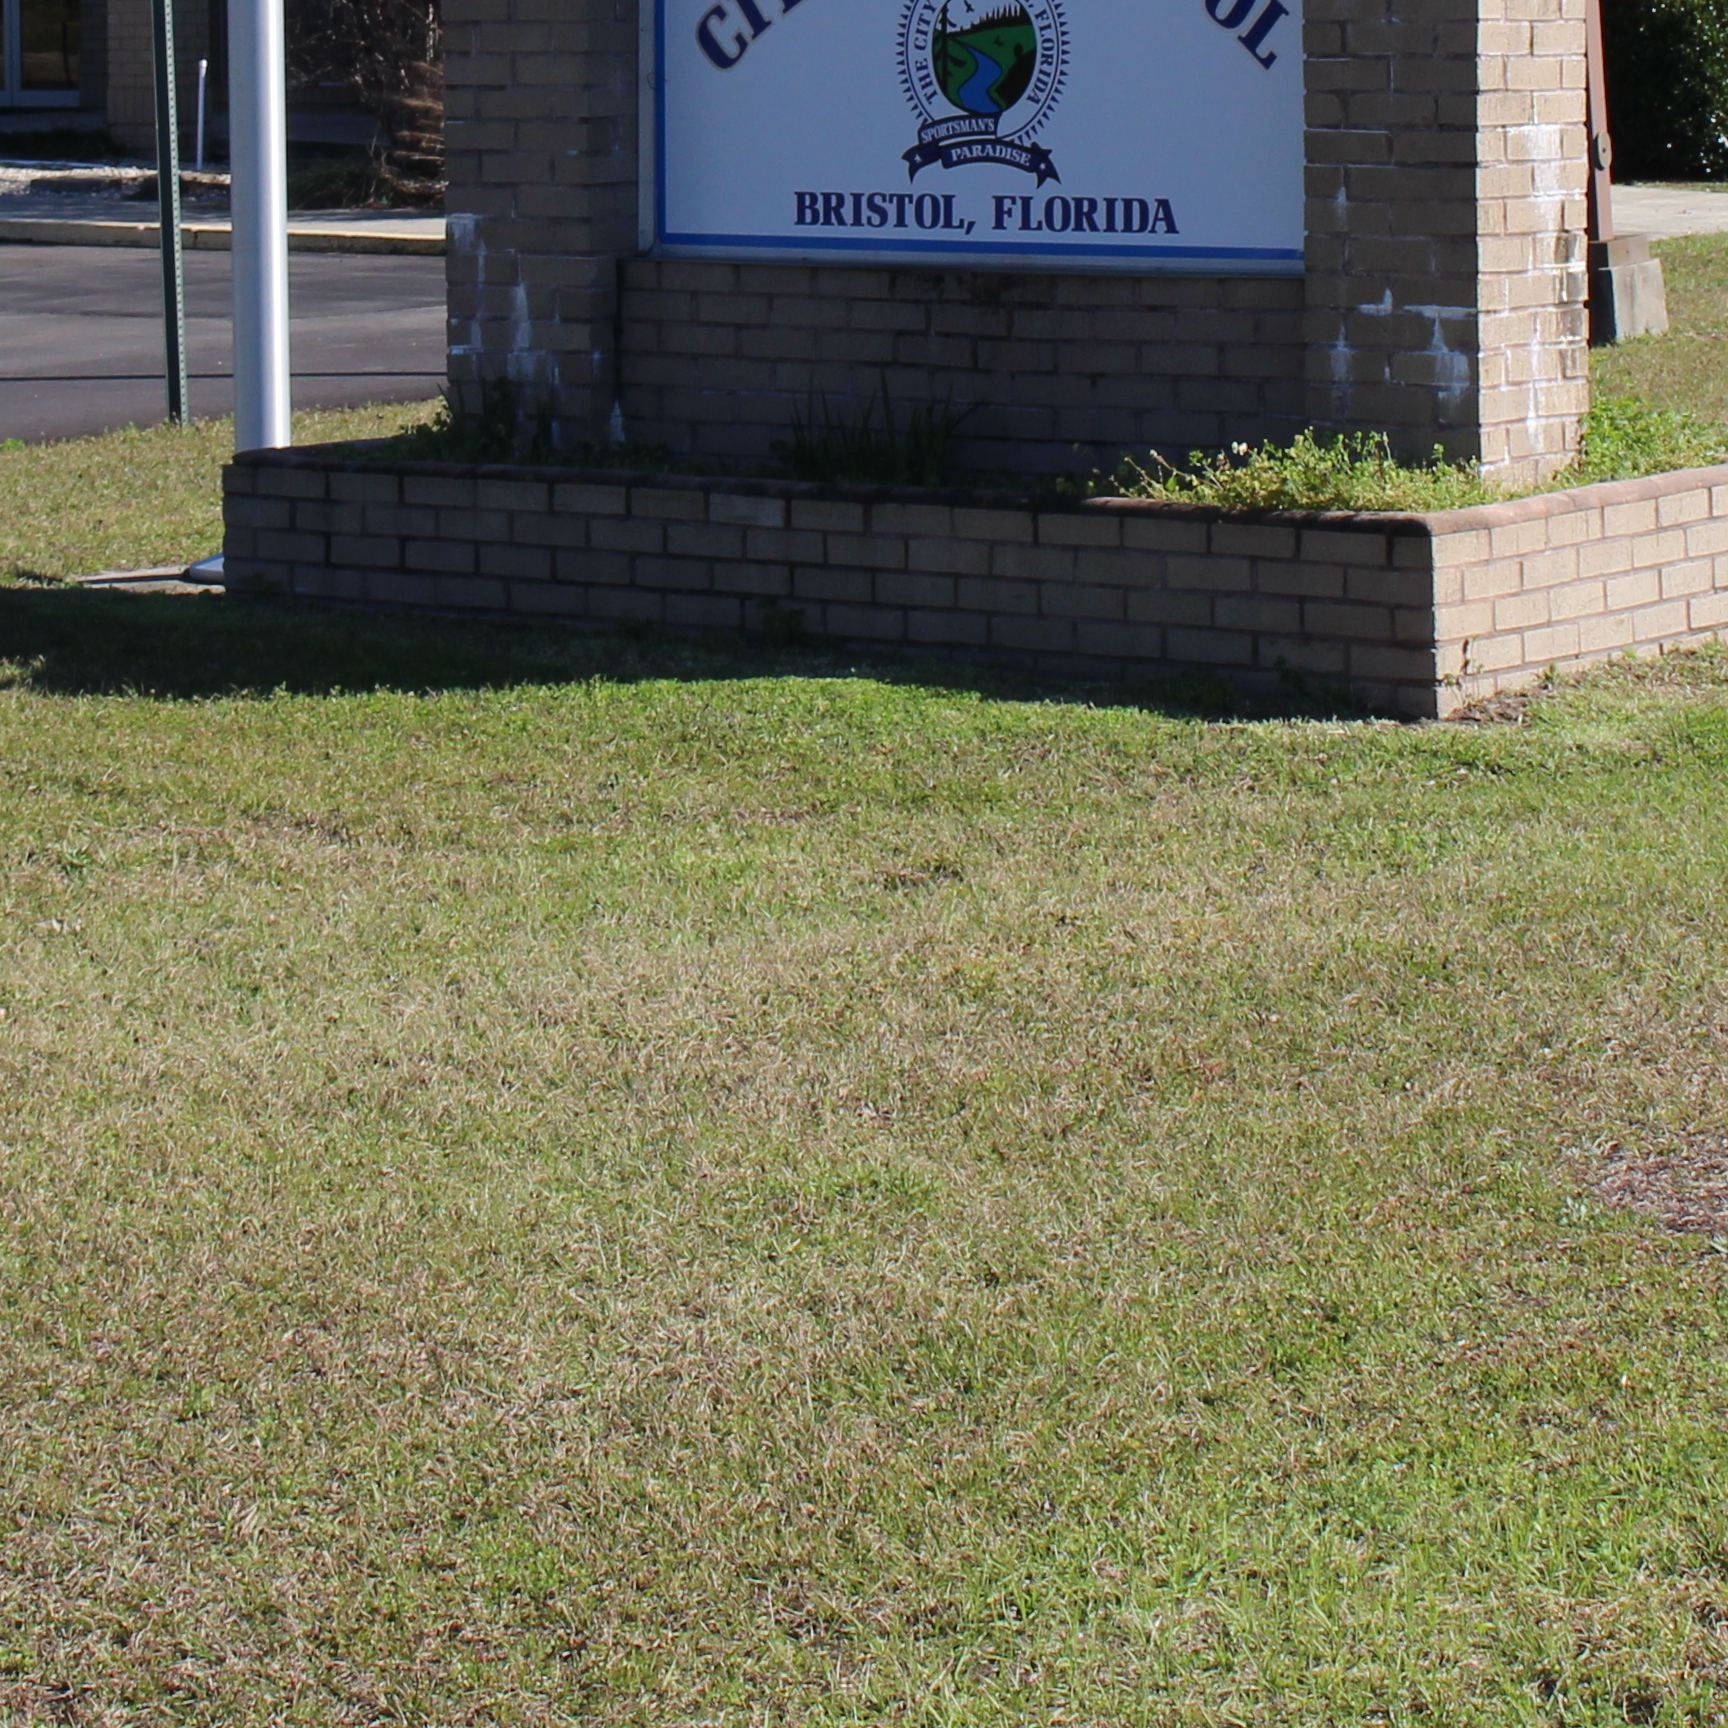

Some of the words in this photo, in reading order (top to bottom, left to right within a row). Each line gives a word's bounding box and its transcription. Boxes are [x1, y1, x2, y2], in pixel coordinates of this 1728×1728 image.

[914, 58, 938, 105] THE
[1027, 8, 1056, 104] FLORIDA
[922, 117, 995, 144] SPORTSMAN'S
[951, 145, 1032, 166] PARADISE
[794, 191, 976, 235] BRISTOL,
[991, 195, 1180, 234] FLORIDA
